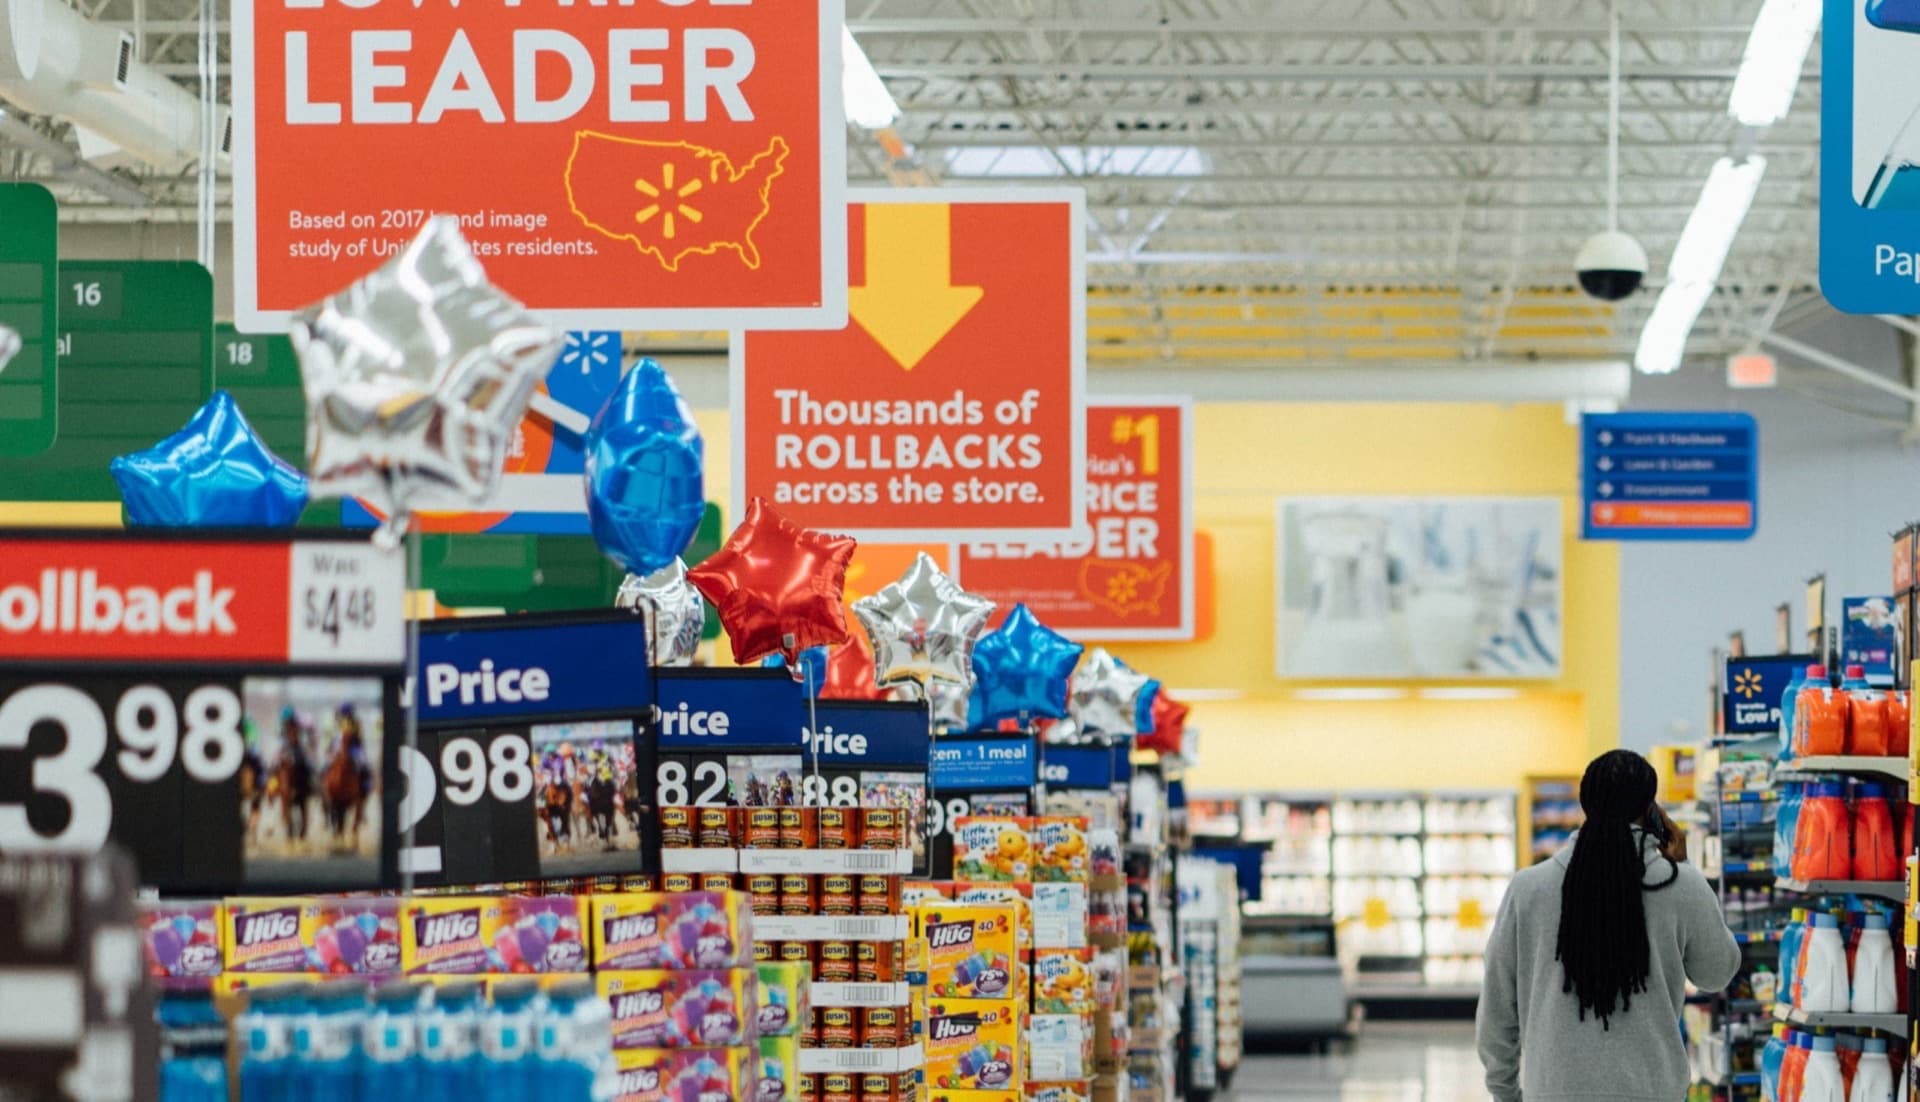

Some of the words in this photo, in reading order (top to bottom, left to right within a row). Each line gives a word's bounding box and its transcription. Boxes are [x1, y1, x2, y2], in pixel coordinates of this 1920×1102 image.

[285, 29, 755, 125] LEADER
[289, 210, 346, 229] Based
[351, 213, 375, 228] on
[381, 210, 424, 228] 2017
[490, 210, 548, 232] image
[289, 239, 342, 262] study
[346, 239, 367, 256] of
[506, 237, 598, 256] residents.
[73, 282, 101, 306] 16
[227, 342, 253, 365] 18
[774, 389, 988, 426] Thousands
[994, 389, 1040, 426] of
[775, 434, 1043, 470] ROLLBACKS
[1111, 414, 1160, 476] #1
[774, 479, 878, 504] across
[888, 476, 944, 504] the
[951, 477, 1045, 504] store.
[0, 568, 236, 634] ollback
[426, 659, 551, 707] Price
[1735, 709, 1769, 724] Low
[977, 744, 985, 760] 1
[989, 743, 1027, 759] meal
[656, 760, 728, 806] 82
[753, 813, 777, 822] BUSH'S
[868, 814, 892, 822] BUSH'S
[666, 879, 690, 888] BUSH'S
[704, 880, 730, 888] BUSH'S
[752, 880, 776, 889] BUSH'S
[783, 880, 806, 889] BUSH'S
[826, 880, 849, 889] BUSH'S
[862, 880, 886, 889] BUSH'S
[243, 911, 298, 945] HUG
[424, 914, 478, 947] HUG
[610, 915, 656, 943] HUG
[978, 920, 994, 931] 40
[932, 926, 972, 947] HUG
[783, 946, 805, 955] BUSH'S
[825, 946, 849, 955] BUSH'S
[617, 991, 662, 1019] HUG
[825, 1012, 849, 1020] BUSH'S
[870, 1012, 894, 1020] BUSH'S
[983, 1012, 997, 1023] 40
[825, 1079, 849, 1087] BUSH'S
[864, 1079, 888, 1087] BUSH'S
